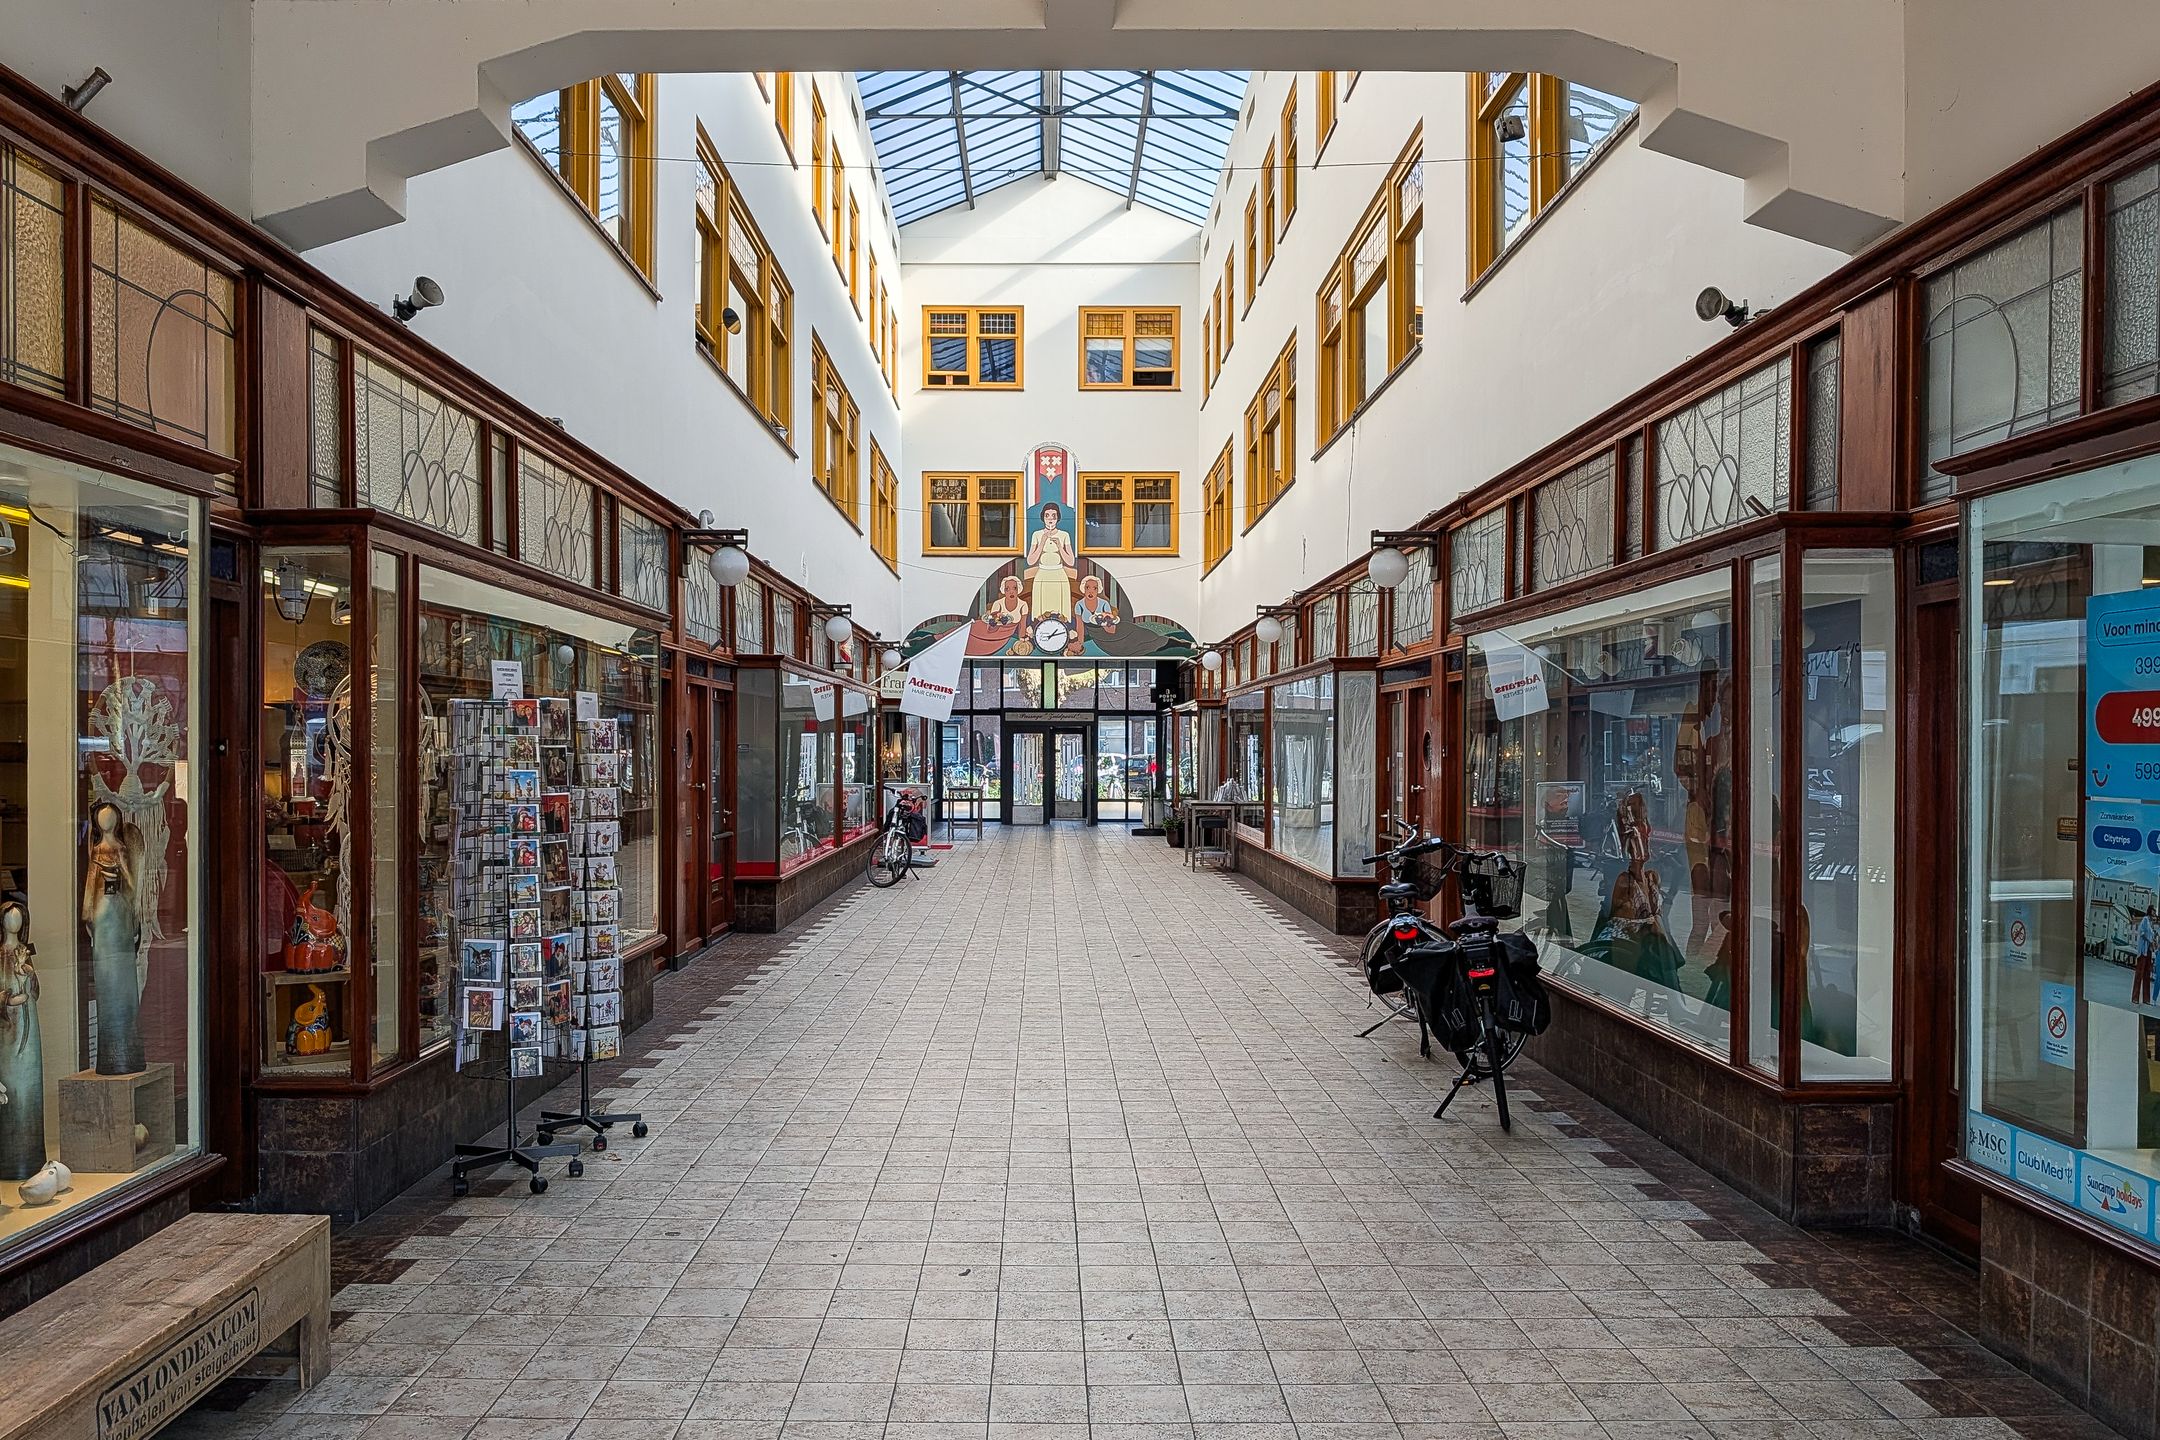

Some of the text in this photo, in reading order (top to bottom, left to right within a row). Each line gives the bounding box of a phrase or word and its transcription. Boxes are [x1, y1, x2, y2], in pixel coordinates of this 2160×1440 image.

[2103, 622, 2132, 638] Voor
[2135, 655, 2160, 675] 399
[908, 677, 954, 695] Aderans
[911, 688, 925, 696] HAIR
[925, 691, 947, 700] CENTER
[2131, 707, 2160, 728] 499
[2134, 762, 2160, 780] 599
[2103, 833, 2131, 845] Citytrips
[2106, 857, 2128, 867] Cruises
[1978, 1129, 2007, 1155] MSC
[2086, 1175, 2143, 1209] Suncamp holidays
[102, 1300, 256, 1429] VANLONDEN.COM
[105, 1329, 256, 1440] eubelen van steigerhout
